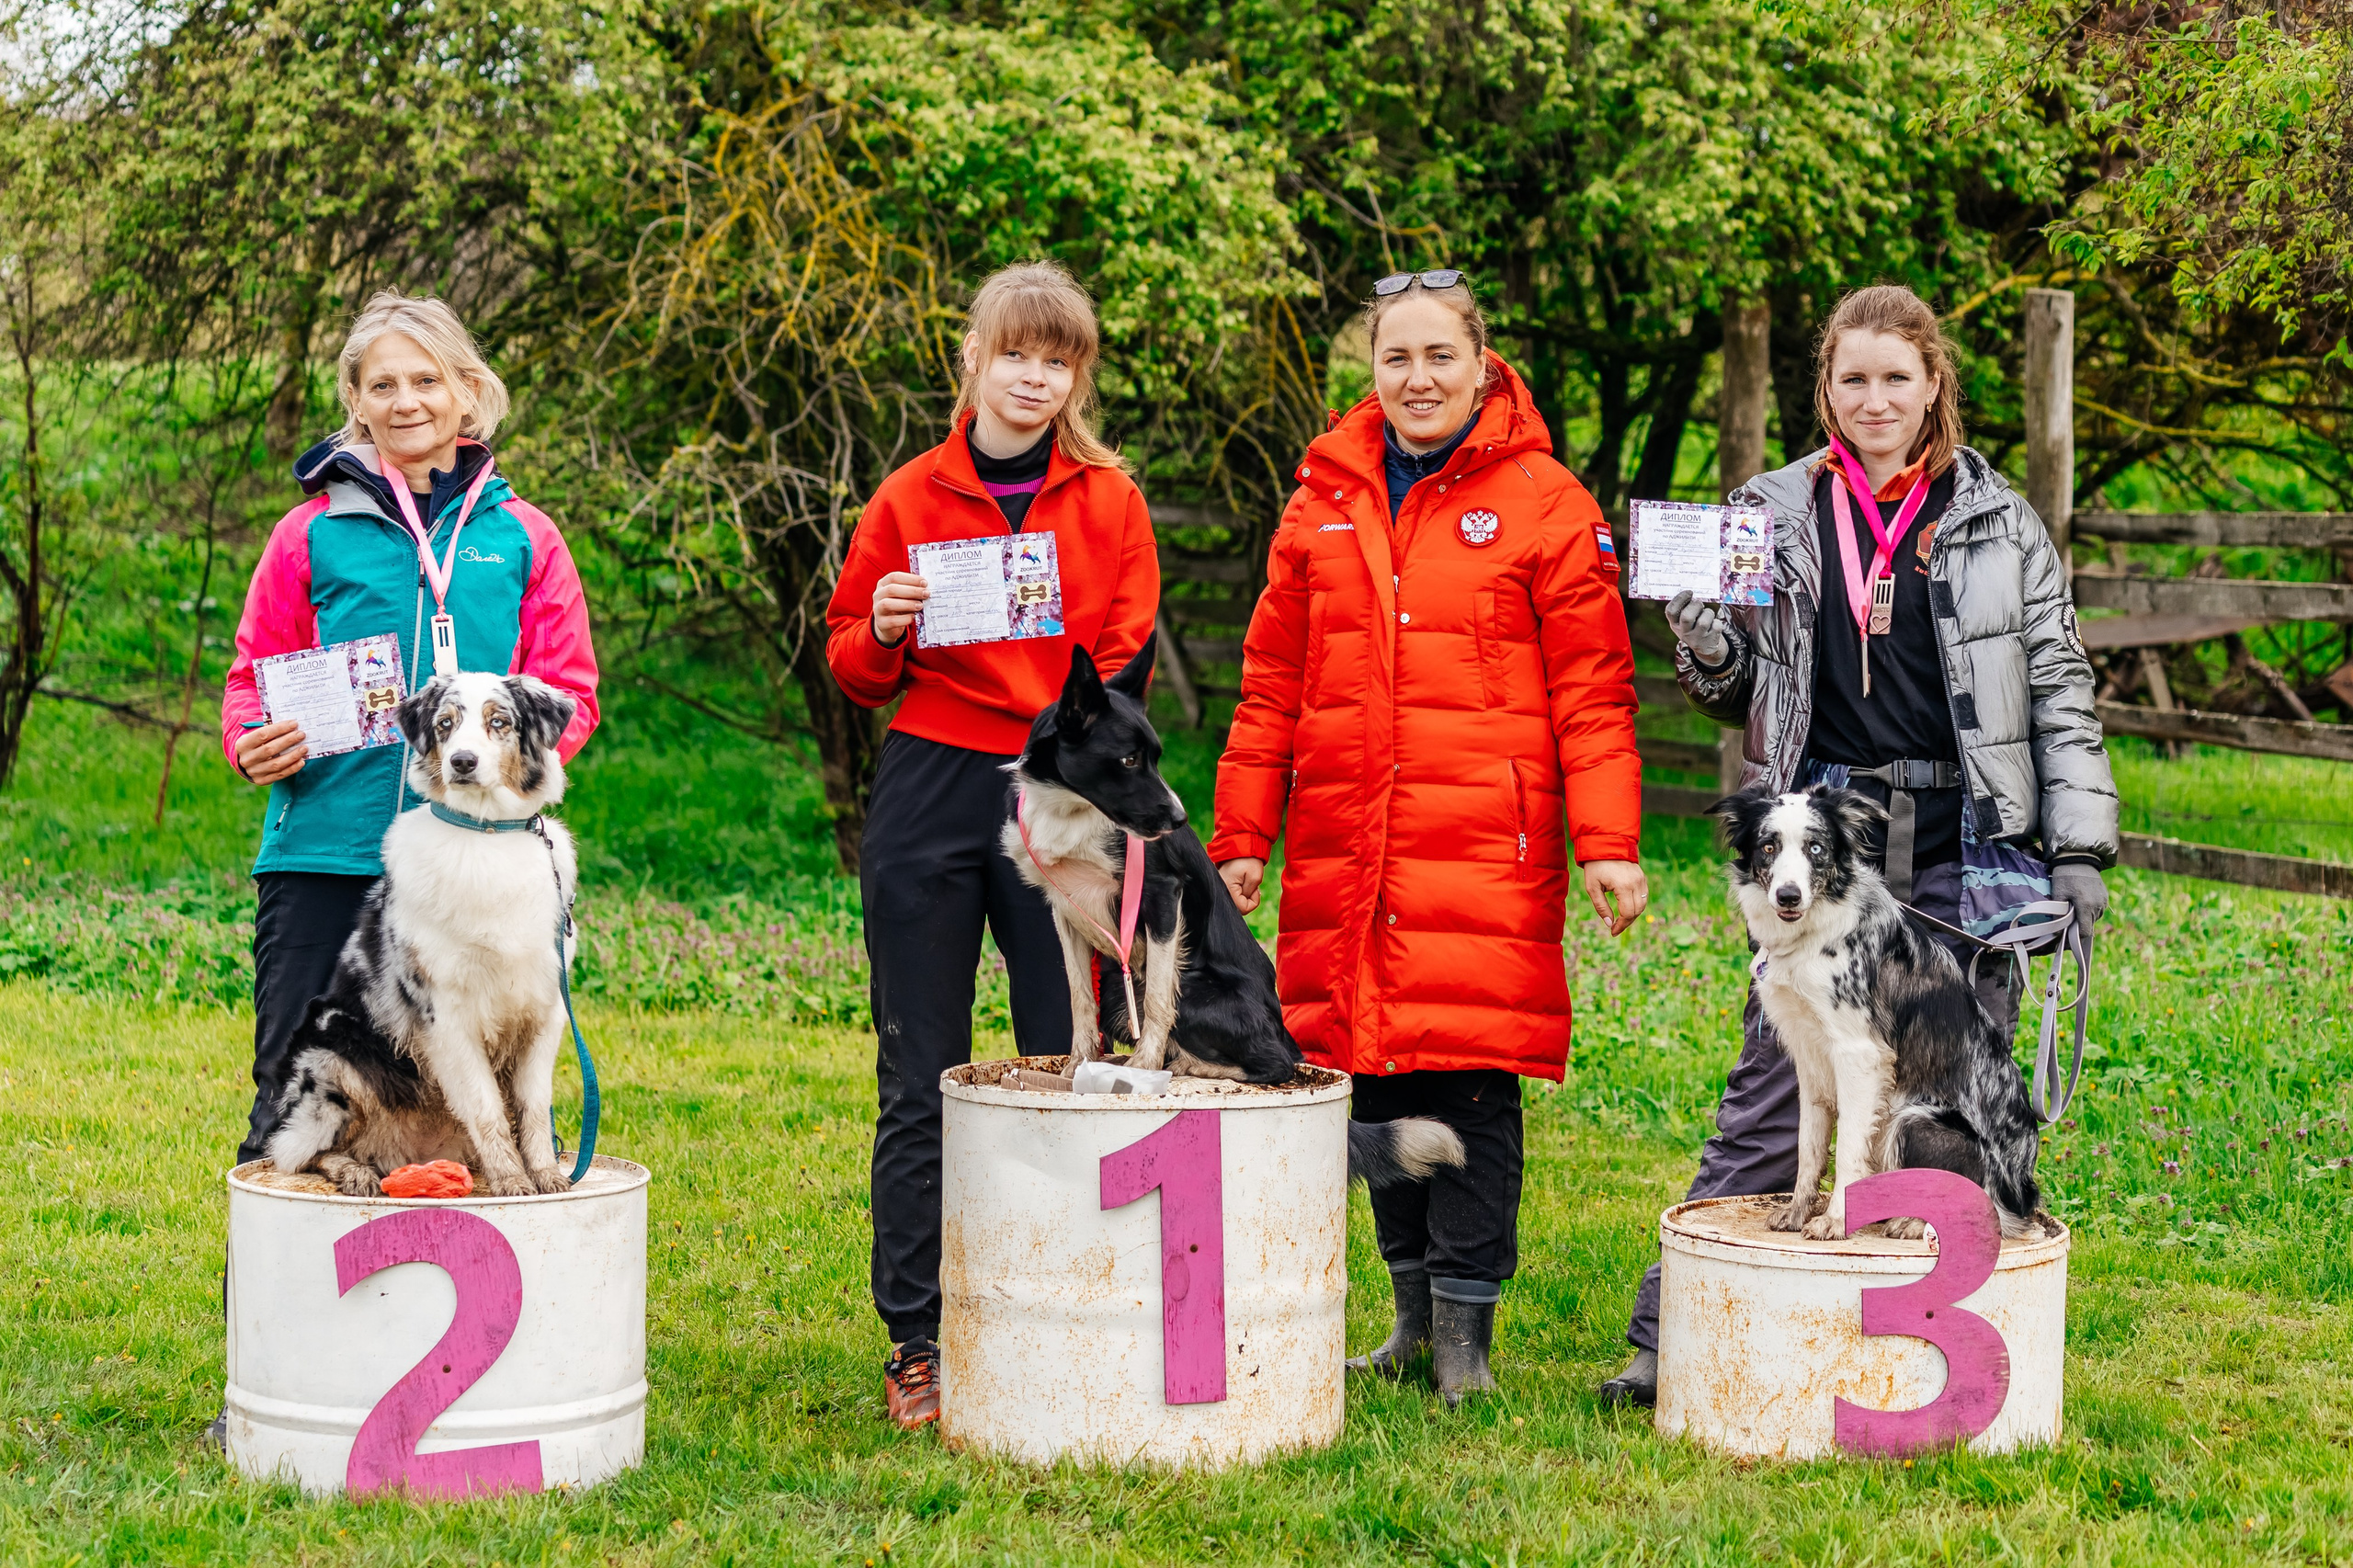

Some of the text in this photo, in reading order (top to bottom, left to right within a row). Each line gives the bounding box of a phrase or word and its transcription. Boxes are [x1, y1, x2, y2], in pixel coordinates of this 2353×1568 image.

[1660, 513, 1701, 522] ДИПЛОМ
[1317, 523, 1355, 532] FORWAR
[940, 551, 983, 562] ДИПЛОМ
[943, 561, 982, 569] НАГРАЖДАЕТСЯ
[287, 658, 328, 676] ДИПЛОМ
[1100, 1109, 1227, 1405] 1
[1835, 1168, 2010, 1460] 3
[334, 1208, 542, 1500] 2
